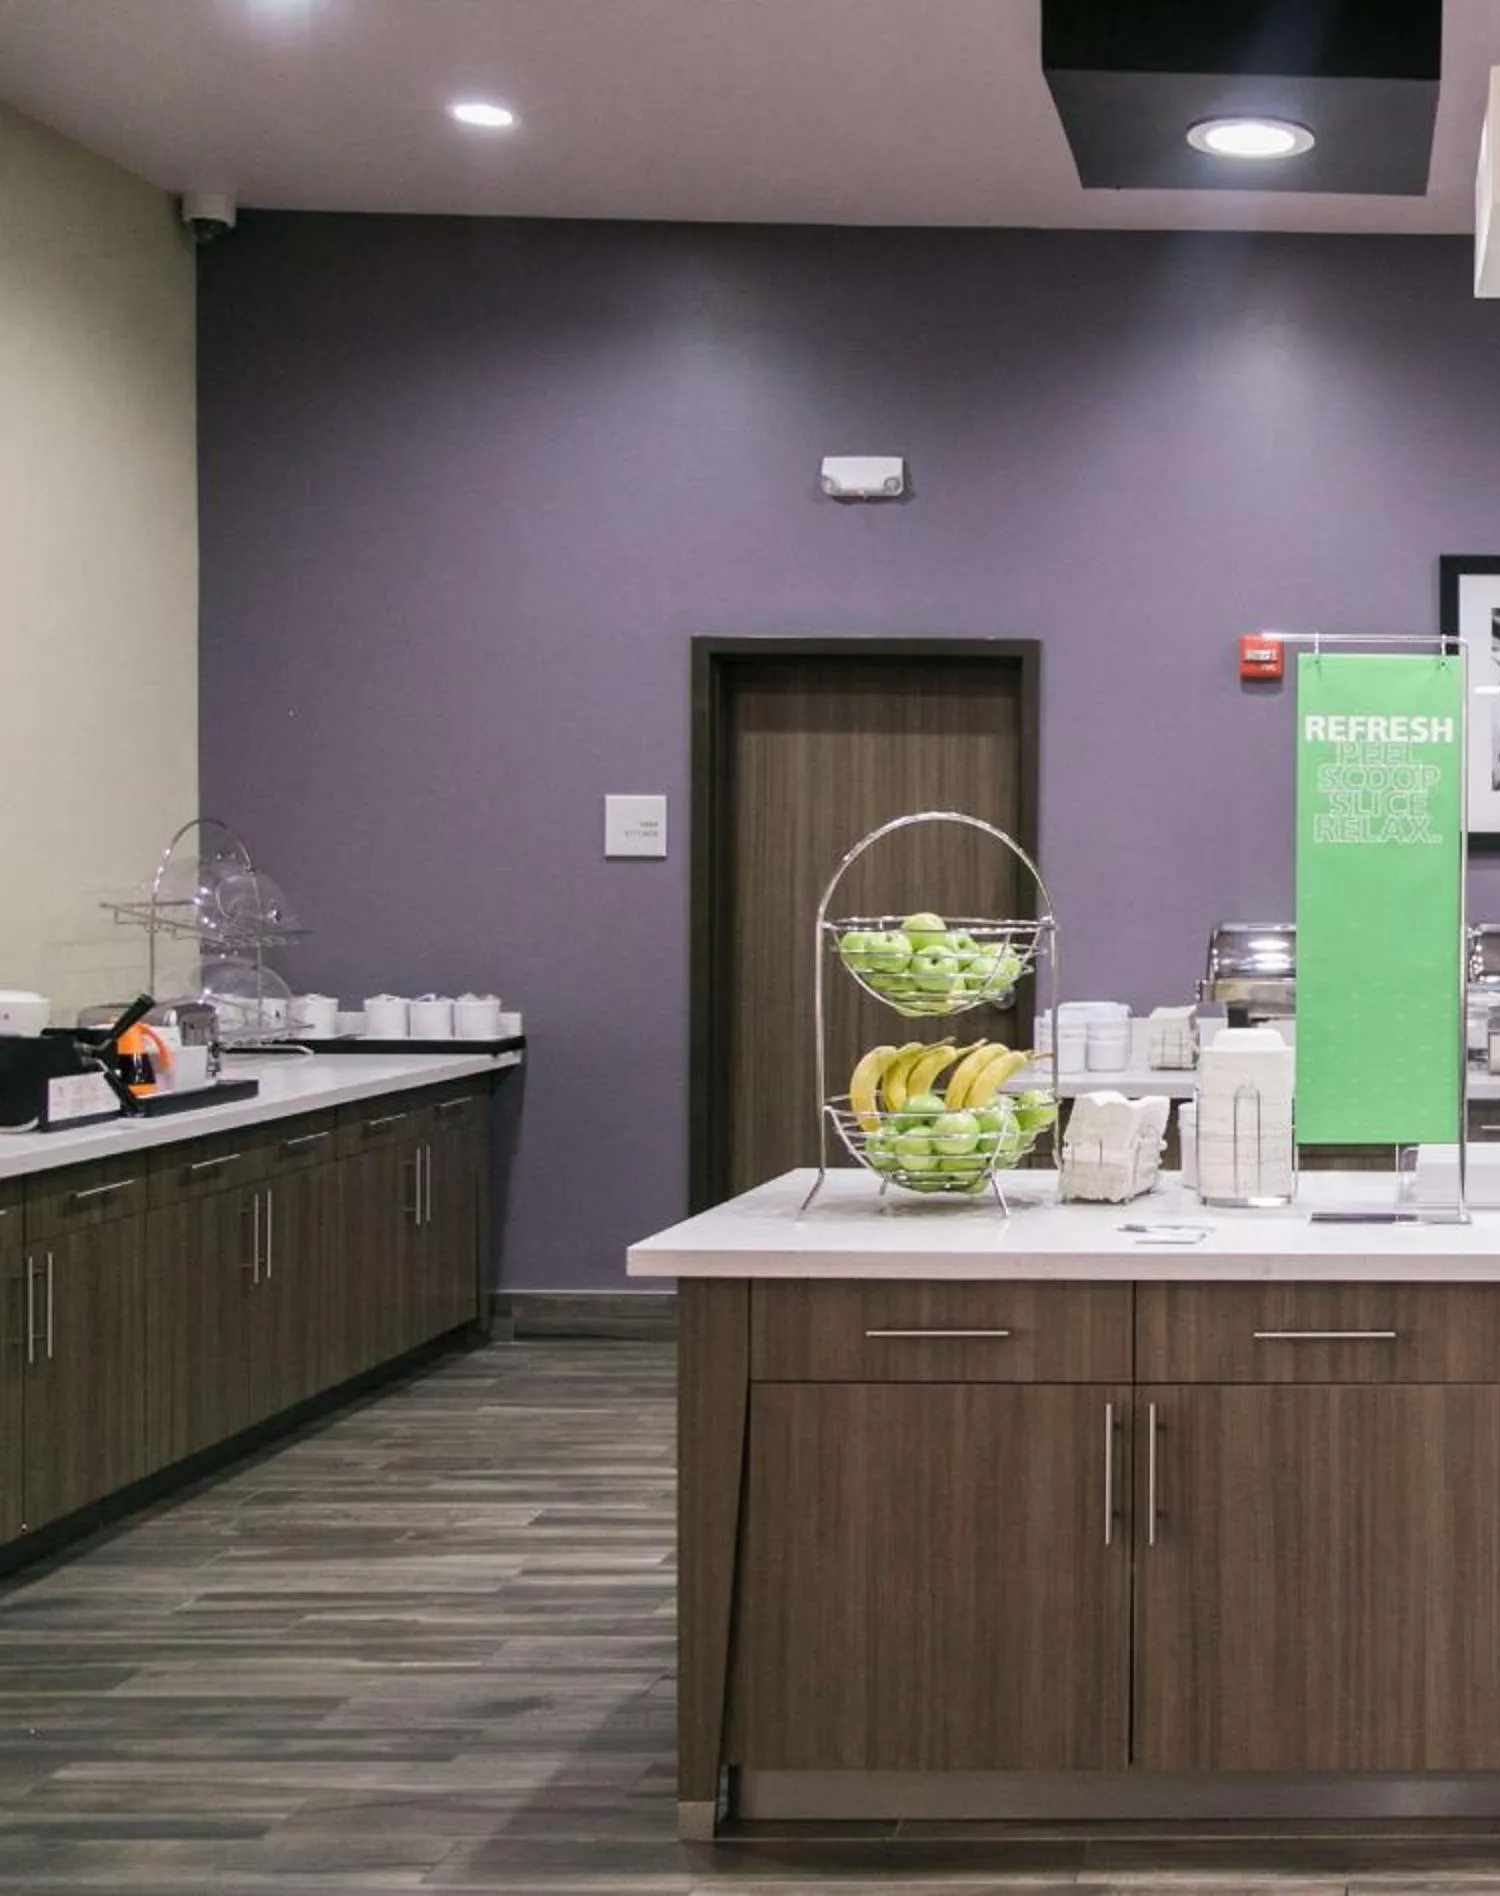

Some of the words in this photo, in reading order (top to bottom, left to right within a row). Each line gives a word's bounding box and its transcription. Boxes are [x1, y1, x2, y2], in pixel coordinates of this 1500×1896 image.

[1305, 715, 1453, 743] REFRESH
[1336, 741, 1423, 766] PEEL
[1318, 764, 1441, 792] SCOOP
[1329, 789, 1429, 817] SLICE
